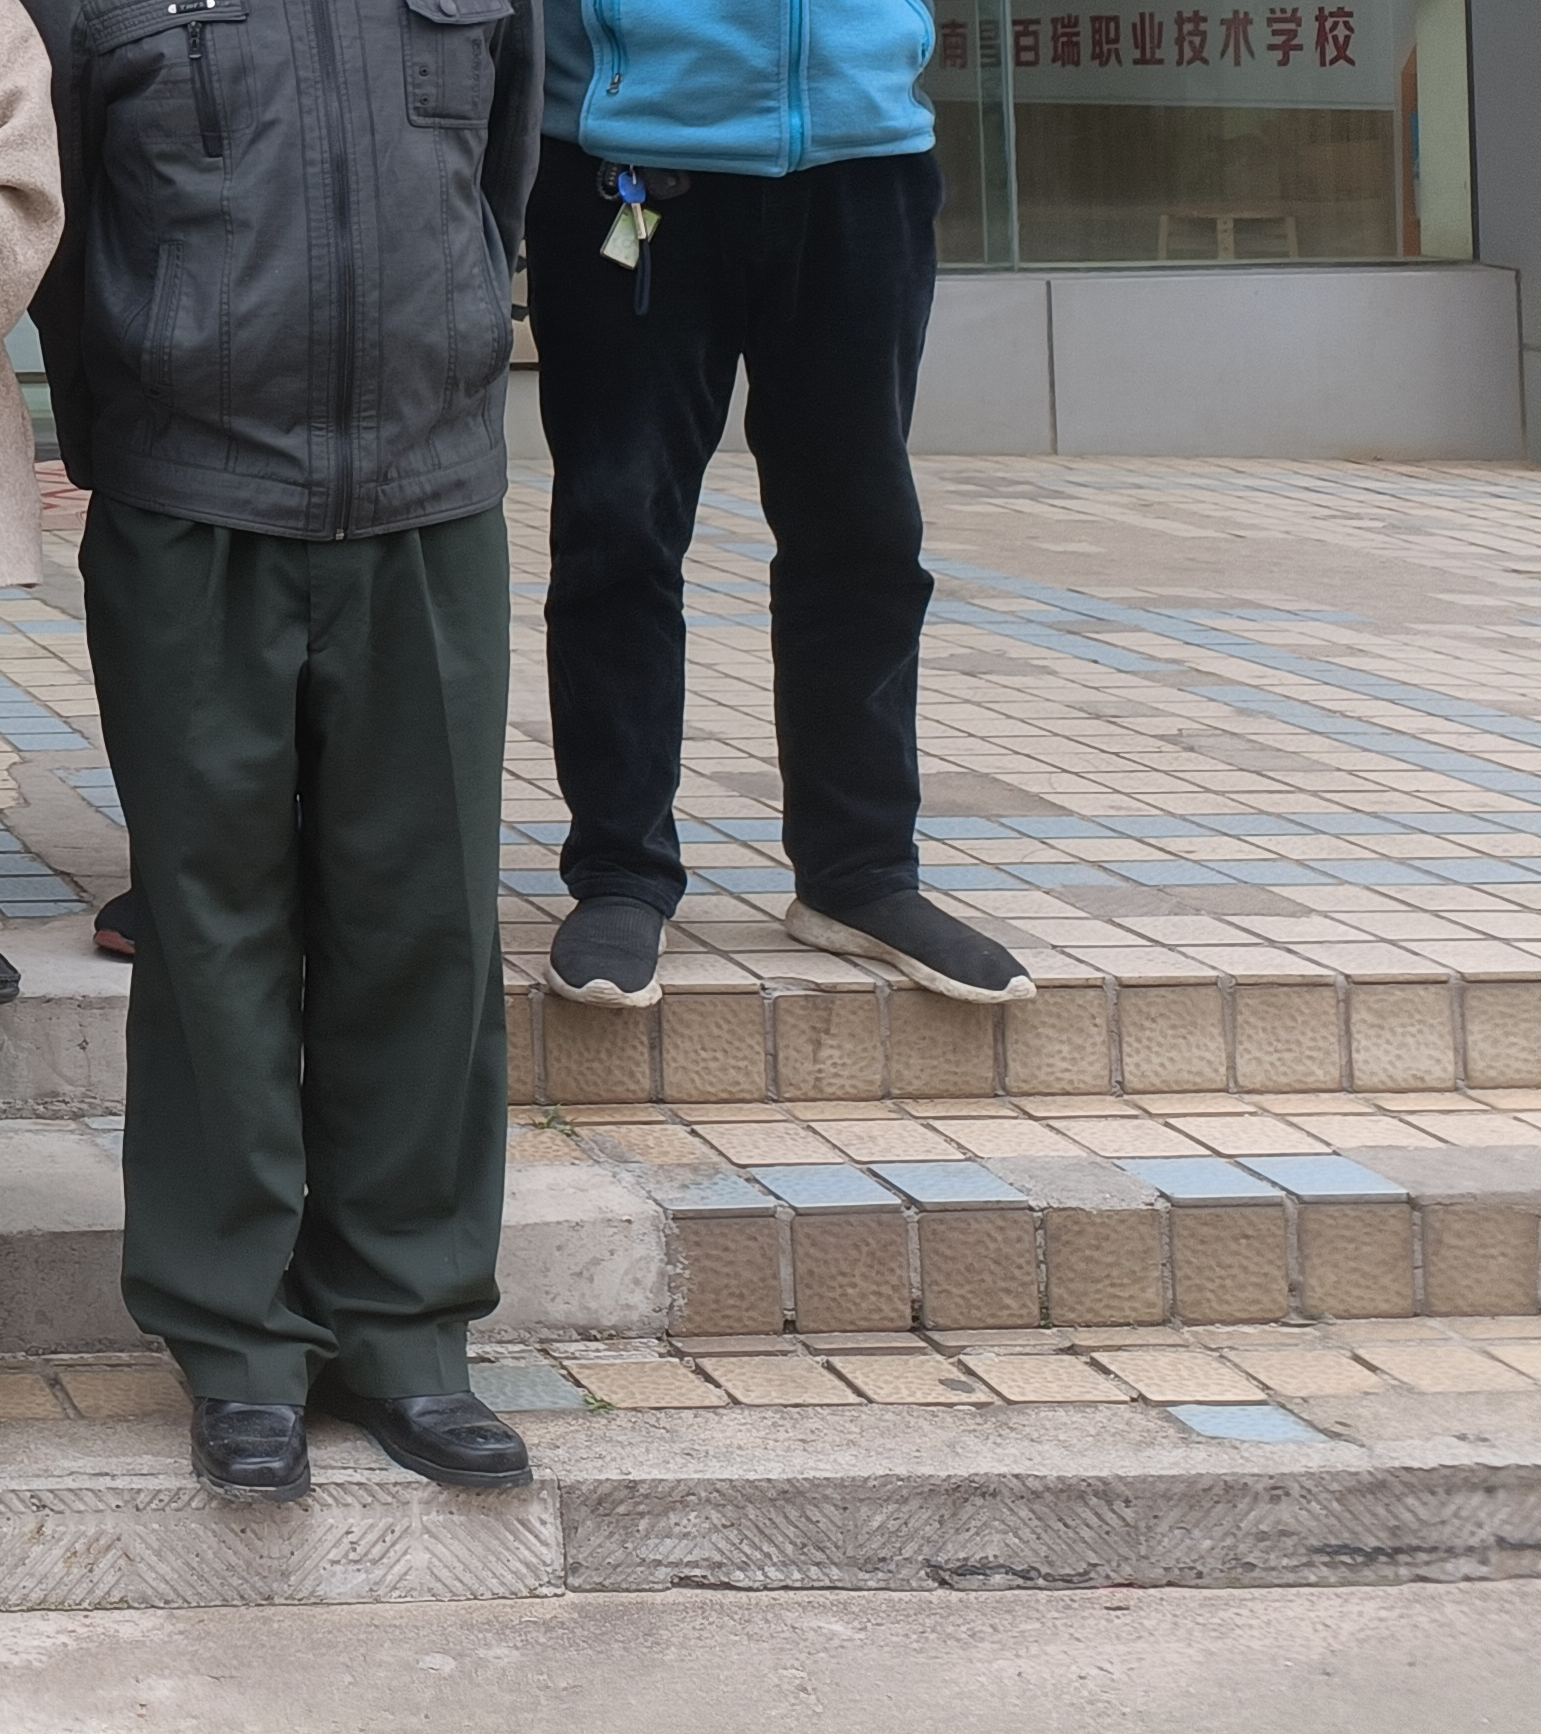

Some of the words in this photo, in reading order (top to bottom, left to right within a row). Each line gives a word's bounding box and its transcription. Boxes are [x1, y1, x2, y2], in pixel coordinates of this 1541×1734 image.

[939, 6, 1357, 69] 南昌百瑞职业技术学校
